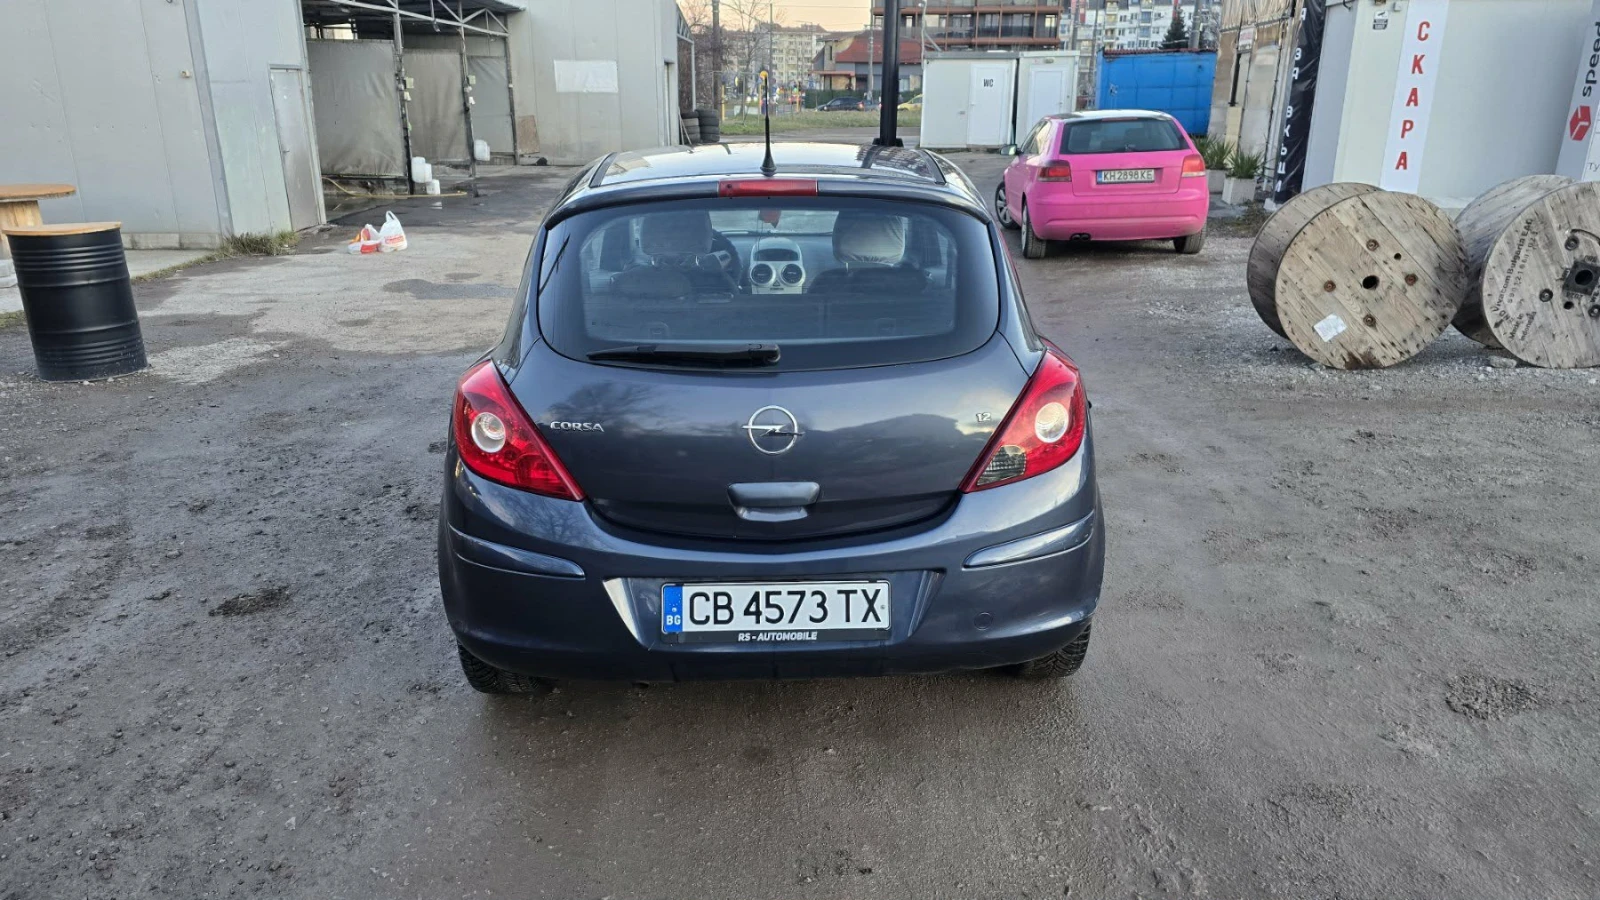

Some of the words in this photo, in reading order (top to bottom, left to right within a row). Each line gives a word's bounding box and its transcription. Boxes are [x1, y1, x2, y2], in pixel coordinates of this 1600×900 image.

[983, 78, 994, 87] WC
[1395, 21, 1431, 170] СКАРА
[550, 421, 605, 432] CORSA
[689, 591, 734, 625] CB
[743, 590, 829, 624] 4573
[837, 588, 882, 623] TX
[666, 614, 681, 625] BG
[757, 631, 818, 641] AUTOMOBILE
